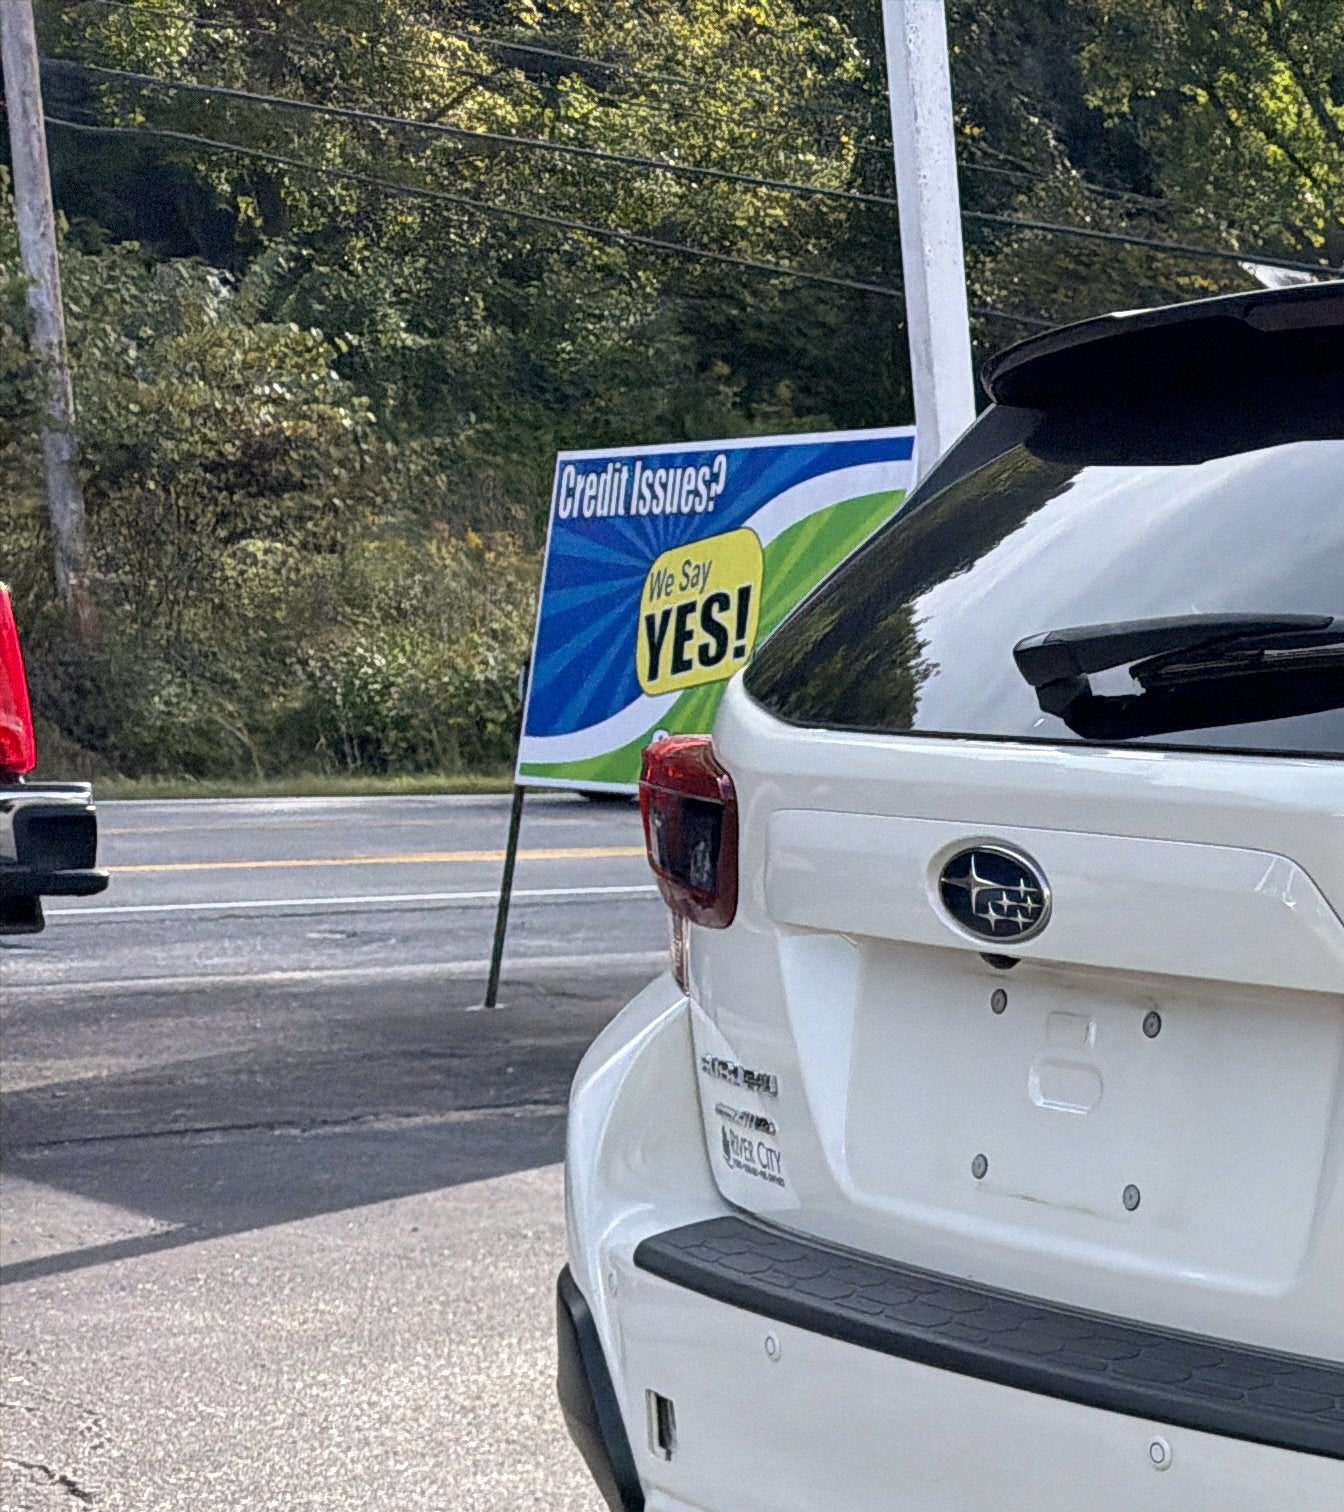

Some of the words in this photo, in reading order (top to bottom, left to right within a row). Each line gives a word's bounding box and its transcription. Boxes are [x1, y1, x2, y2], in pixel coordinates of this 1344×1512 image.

[558, 462, 629, 519] Credit
[631, 453, 728, 517] Issues?
[648, 570, 675, 601] We
[680, 558, 713, 593] Say
[644, 584, 753, 684] YES!
